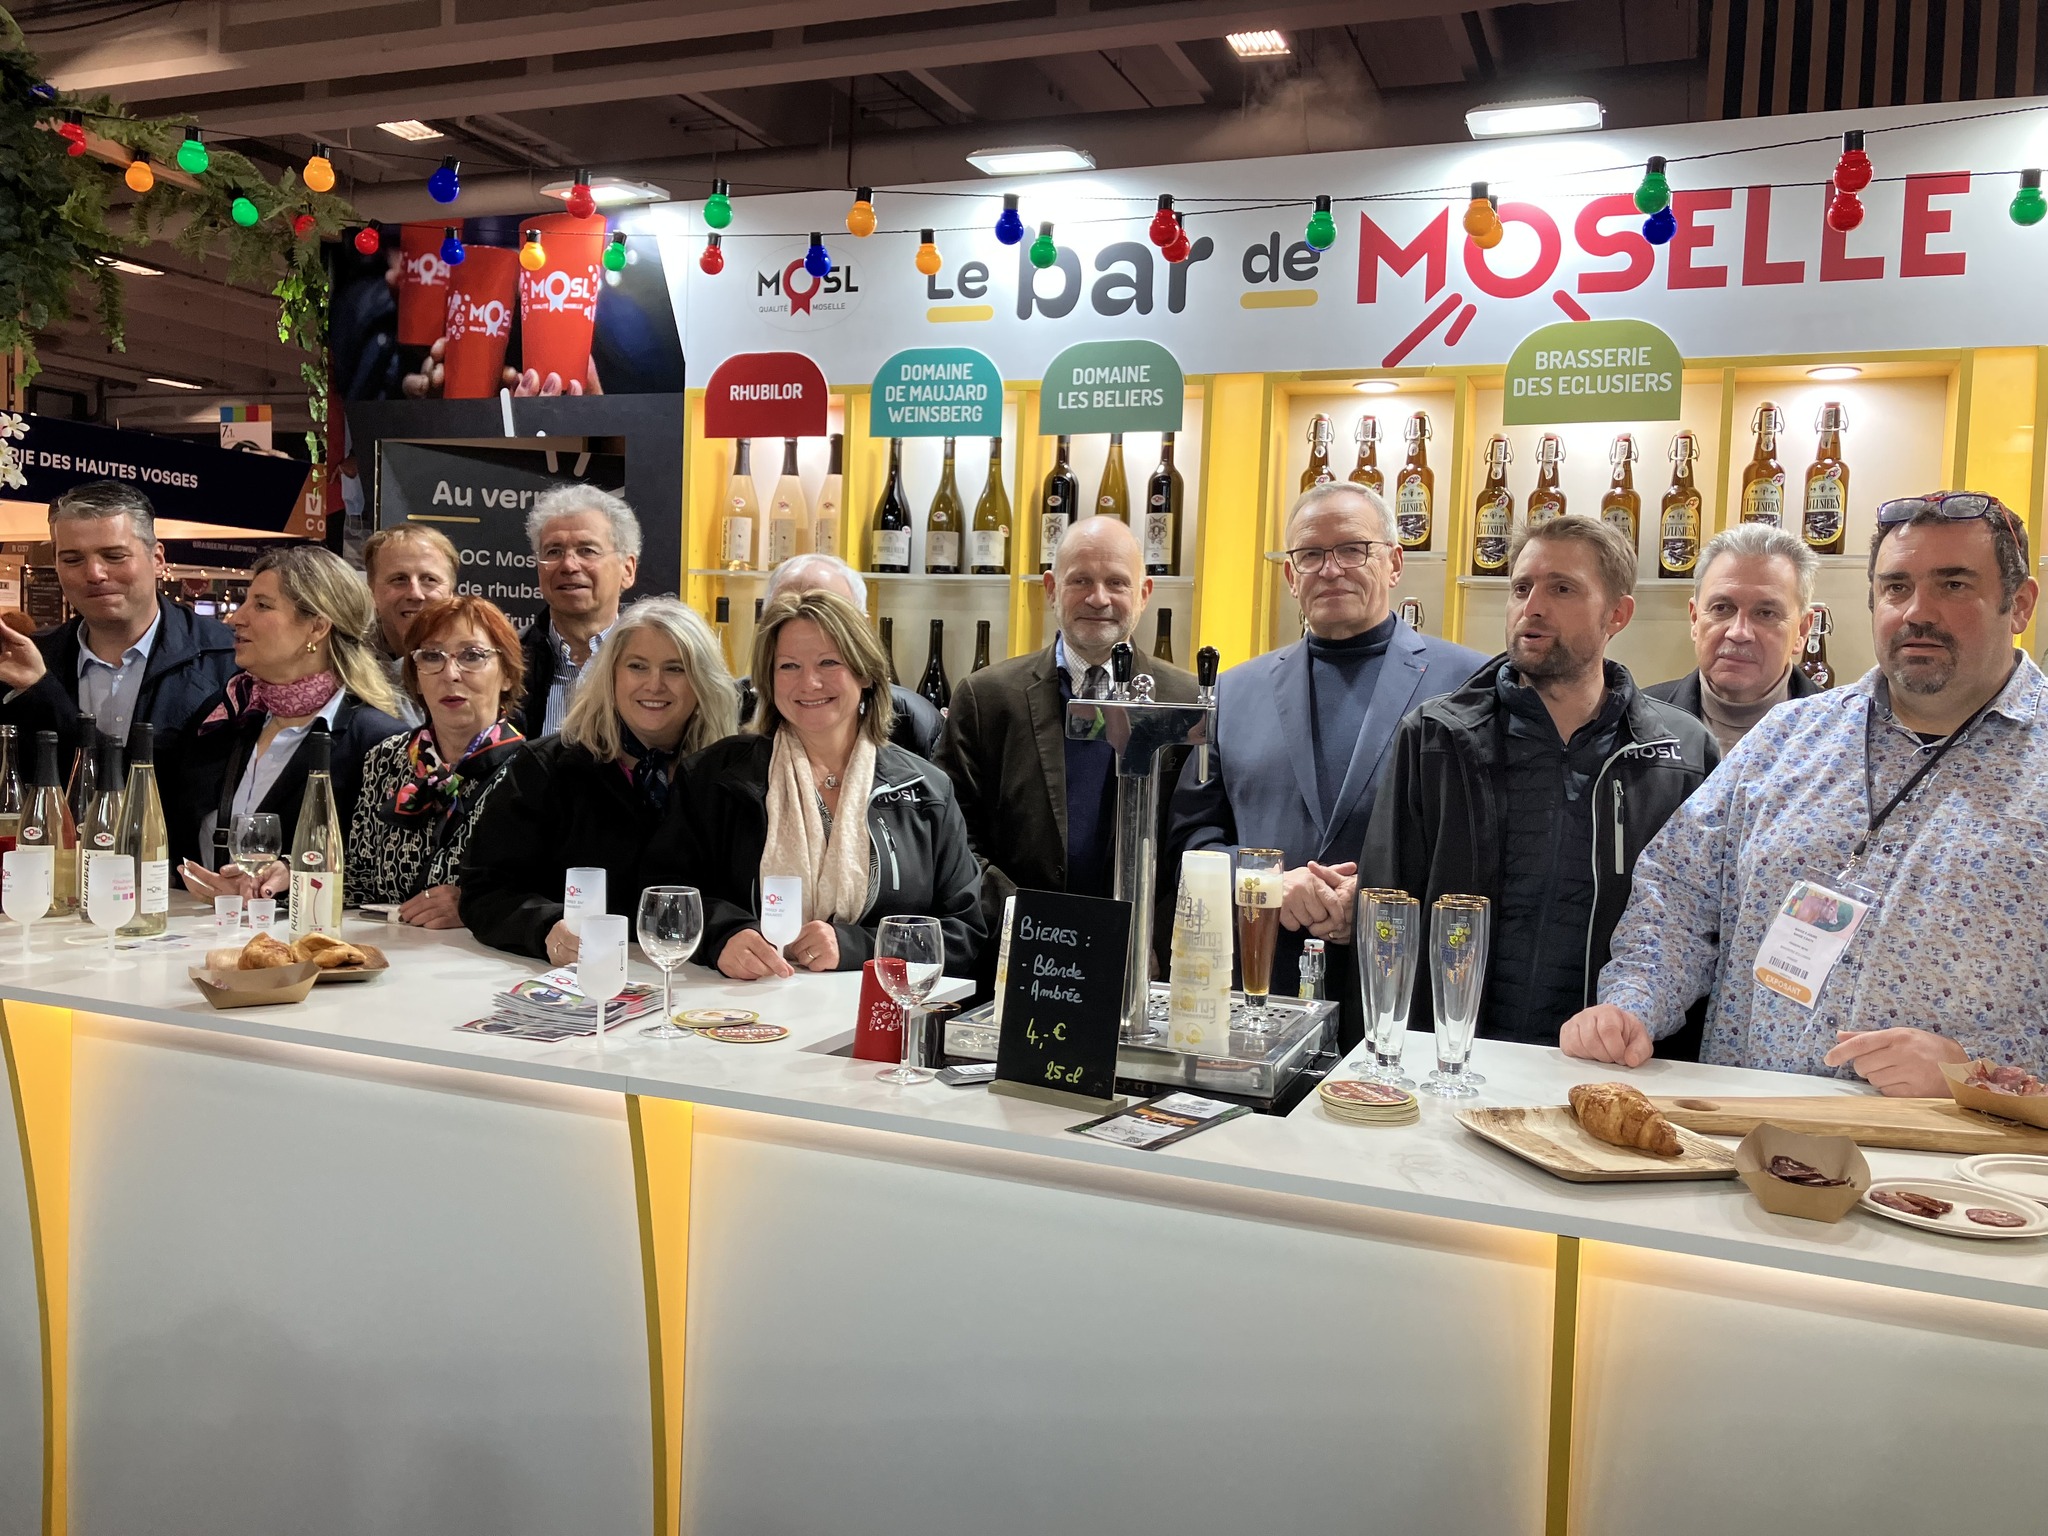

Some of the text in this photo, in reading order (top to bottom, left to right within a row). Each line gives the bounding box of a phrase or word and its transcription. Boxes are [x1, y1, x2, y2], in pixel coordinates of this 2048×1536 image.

[927, 170, 1972, 321] Le bar de MOSELLE
[530, 271, 590, 304] MOSL
[756, 258, 859, 306] MOSL
[758, 302, 846, 313] QUALITÉ MOSELLE
[1535, 346, 1652, 370] BRASSERIE
[900, 362, 974, 381] DOMAINE
[1072, 364, 1151, 386] DOMAINE
[729, 382, 804, 401] RHUBILOR
[885, 383, 988, 403] DE MAUJARD
[1512, 372, 1673, 397] DES ECLUSIERS
[1058, 387, 1164, 410] LES BELIERS
[888, 405, 983, 423] WEINSBERG
[39, 451, 71, 471] DES
[76, 458, 138, 481] HAUTES
[140, 467, 199, 488] VOSGES
[431, 480, 548, 510] Au verr
[459, 549, 537, 569] OC Mos
[457, 580, 545, 600] de rhuba
[504, 613, 536, 630] frui
[1624, 745, 1682, 760] MOSL
[290, 874, 300, 931] RHUBILOR
[1033, 953, 1086, 980] Blonde
[1764, 973, 1802, 997] EXPOSANT
